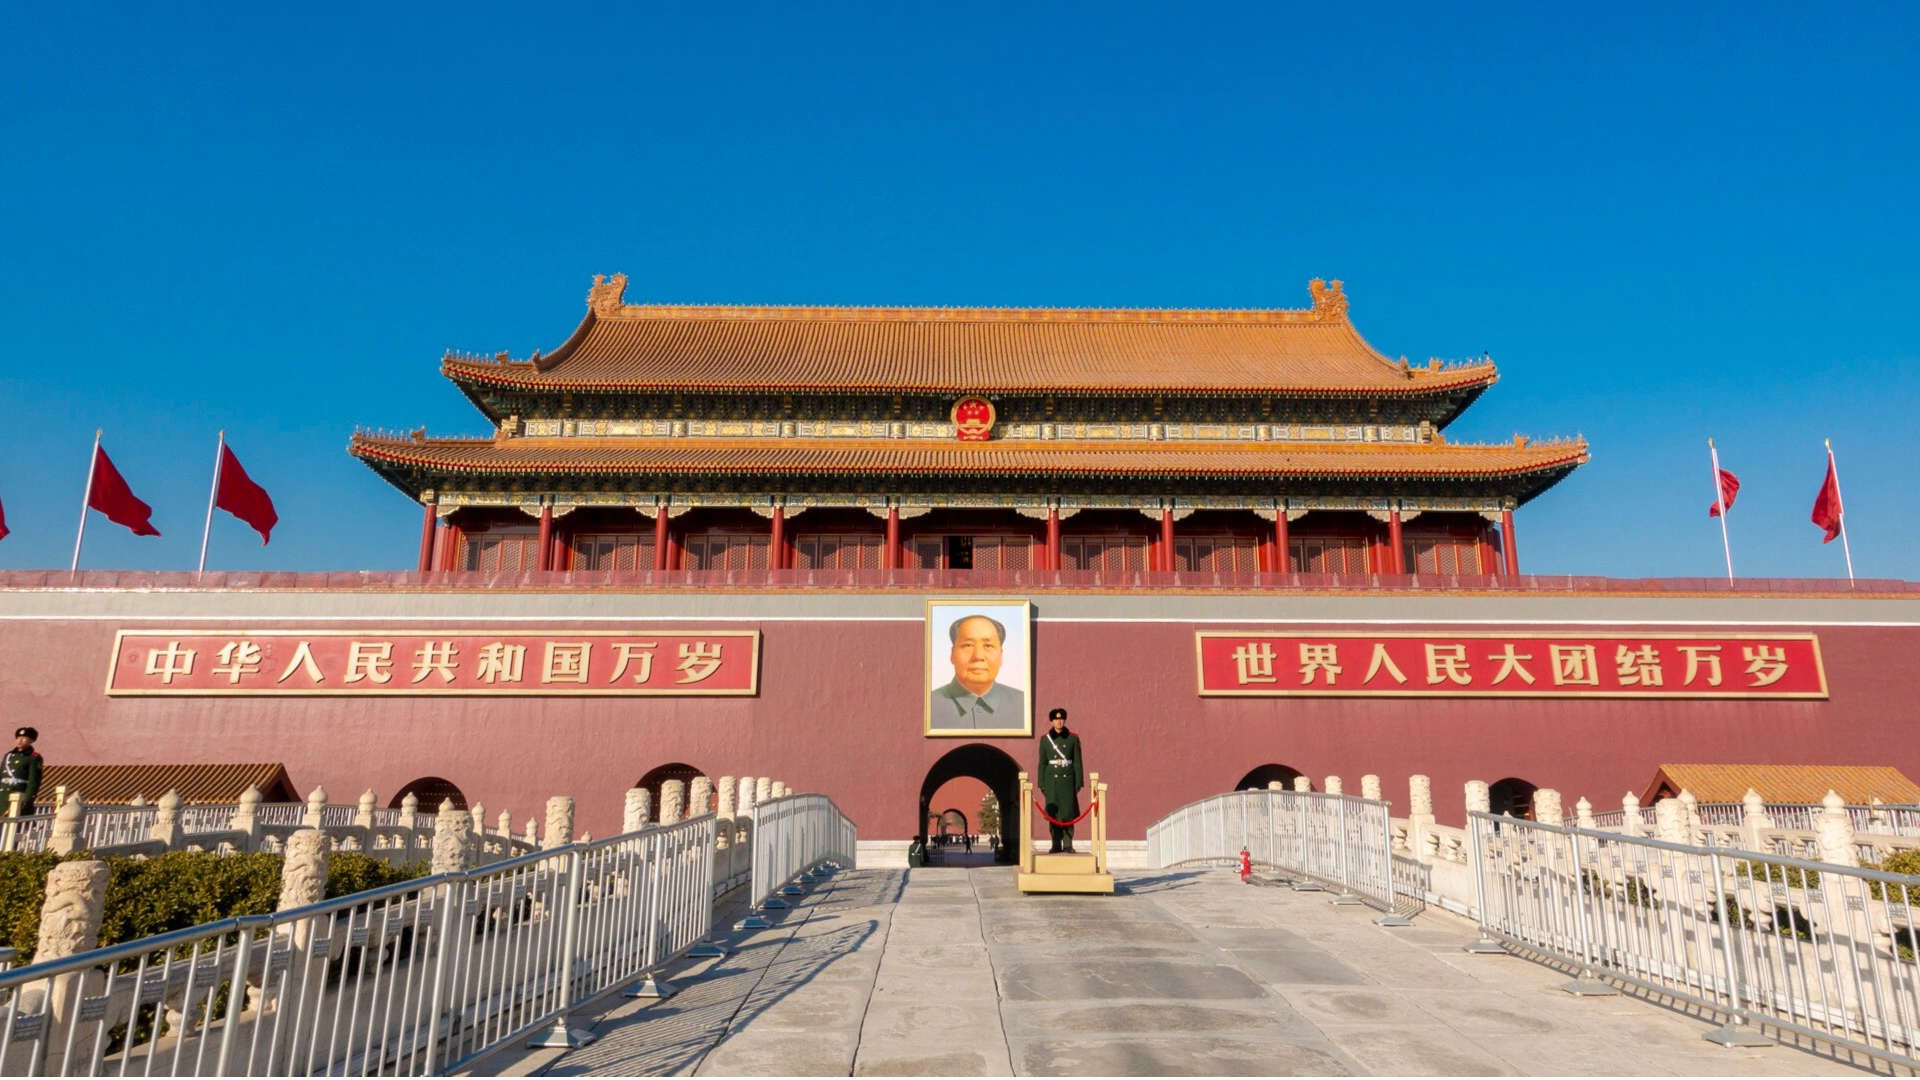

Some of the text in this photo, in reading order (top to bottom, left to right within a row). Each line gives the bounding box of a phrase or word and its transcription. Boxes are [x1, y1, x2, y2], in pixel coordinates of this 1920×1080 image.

[145, 641, 723, 684] 中华人民共和国万岁
[1232, 643, 1789, 687] 世界人民大团结万岁
